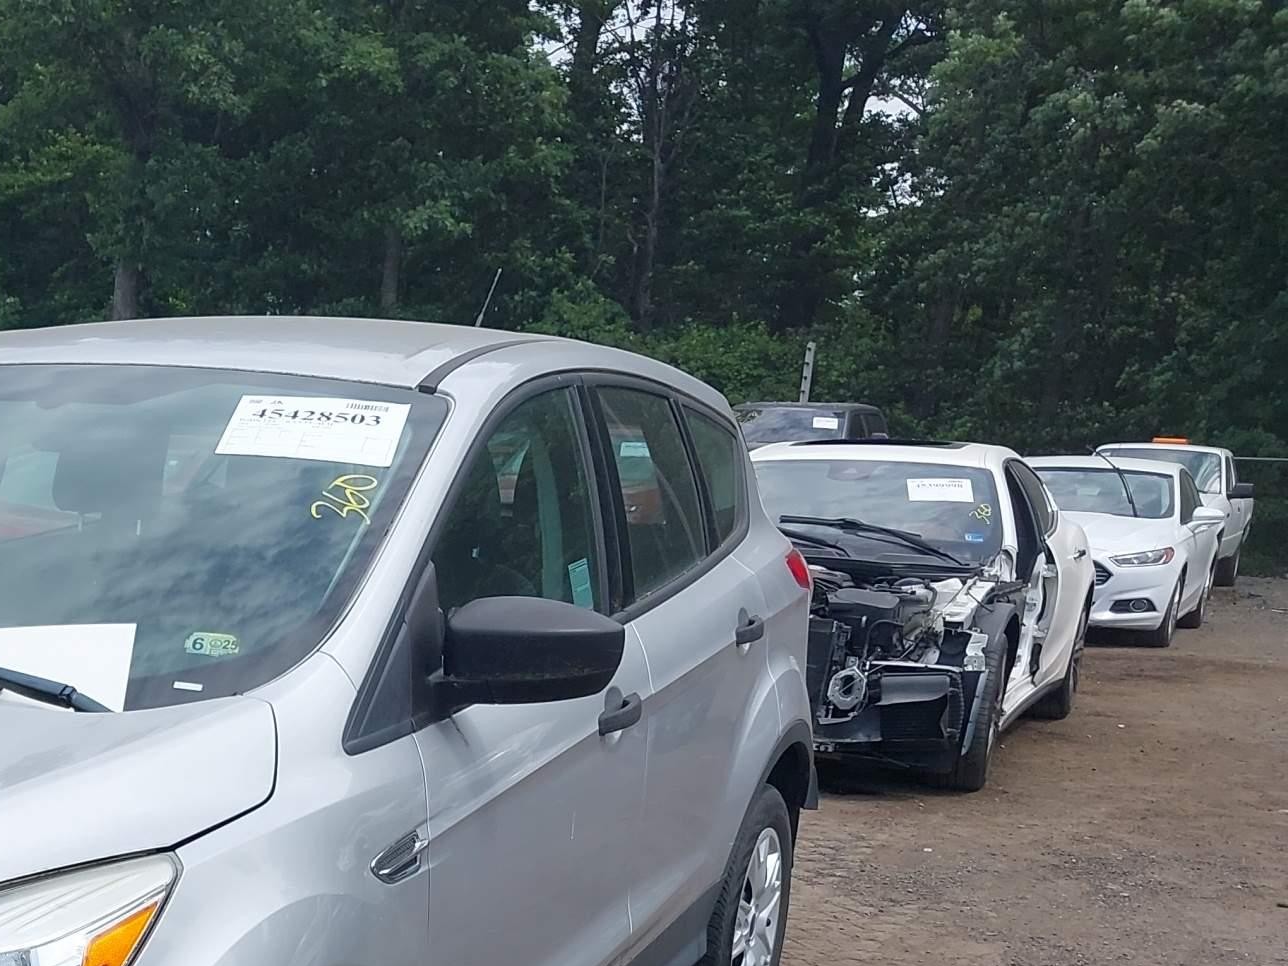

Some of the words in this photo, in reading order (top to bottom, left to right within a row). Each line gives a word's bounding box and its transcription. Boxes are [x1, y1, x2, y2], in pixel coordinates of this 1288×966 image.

[251, 408, 381, 427] 45428503
[310, 474, 378, 525] 360
[192, 637, 205, 651] 6
